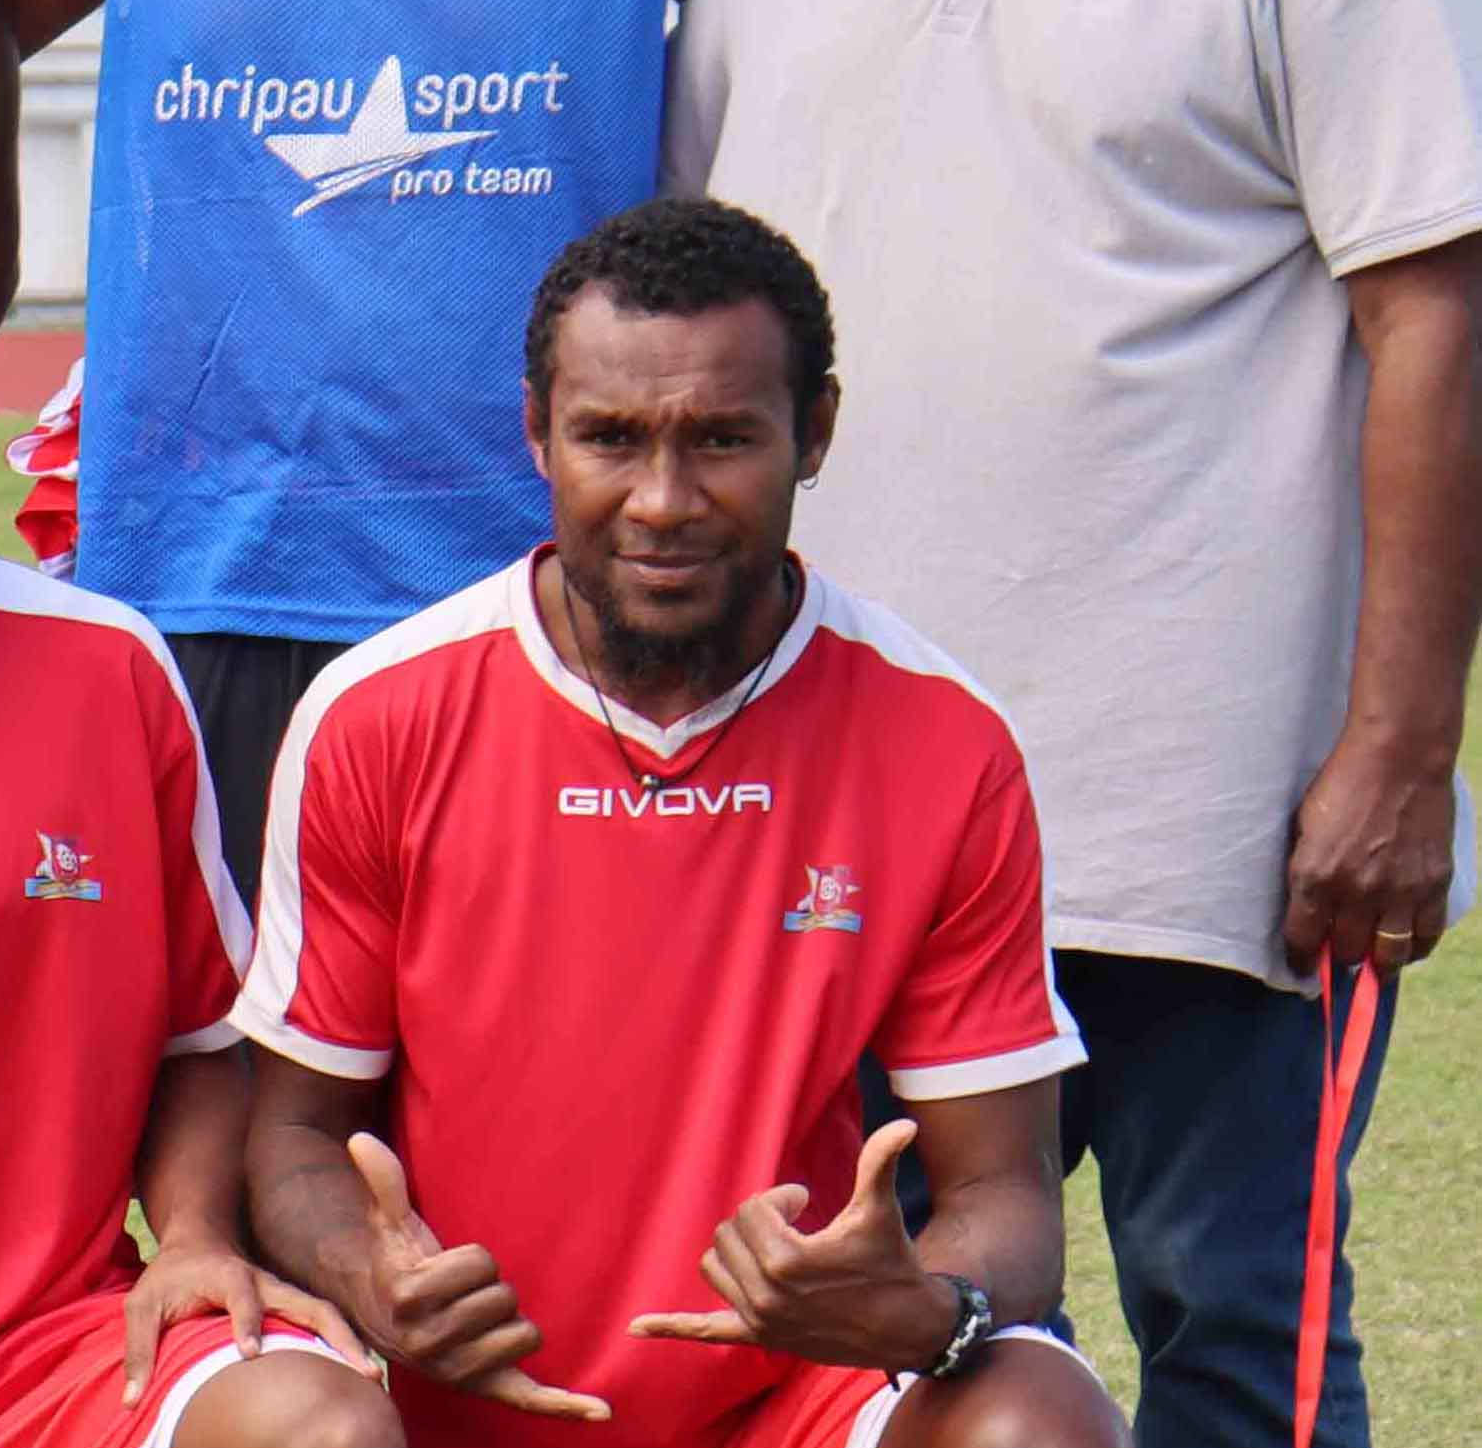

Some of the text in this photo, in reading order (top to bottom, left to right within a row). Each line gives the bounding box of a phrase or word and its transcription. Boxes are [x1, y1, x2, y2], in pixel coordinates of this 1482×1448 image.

[155, 62, 570, 134] chripau sport
[392, 160, 552, 203] pro team
[558, 783, 771, 818] GIVOVA
